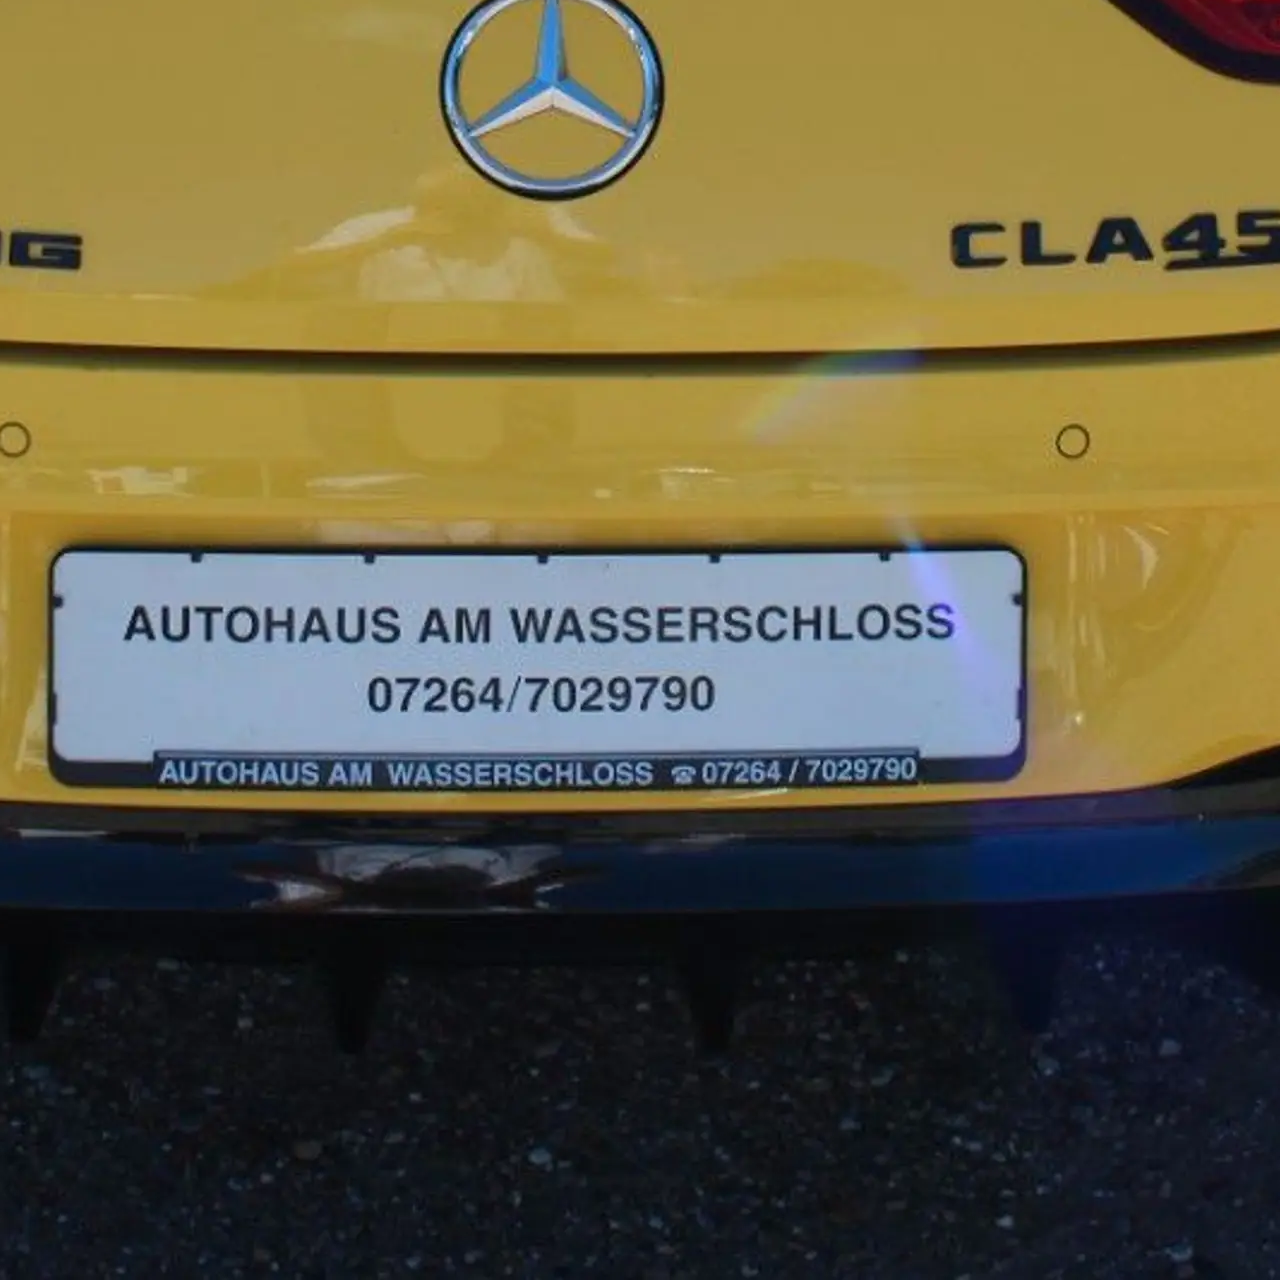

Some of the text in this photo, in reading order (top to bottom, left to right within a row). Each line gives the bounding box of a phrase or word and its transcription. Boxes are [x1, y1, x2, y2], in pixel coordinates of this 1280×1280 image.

[123, 603, 957, 644] AUTOHAUS AM WASSERSCHLOSS
[367, 675, 717, 713] 07264/7029790
[159, 759, 320, 786] AUTOHAUS
[328, 761, 372, 787] AM
[387, 761, 654, 787] WASSERSCHLOSS
[702, 759, 782, 785] 07264
[806, 756, 917, 783] 7029790
